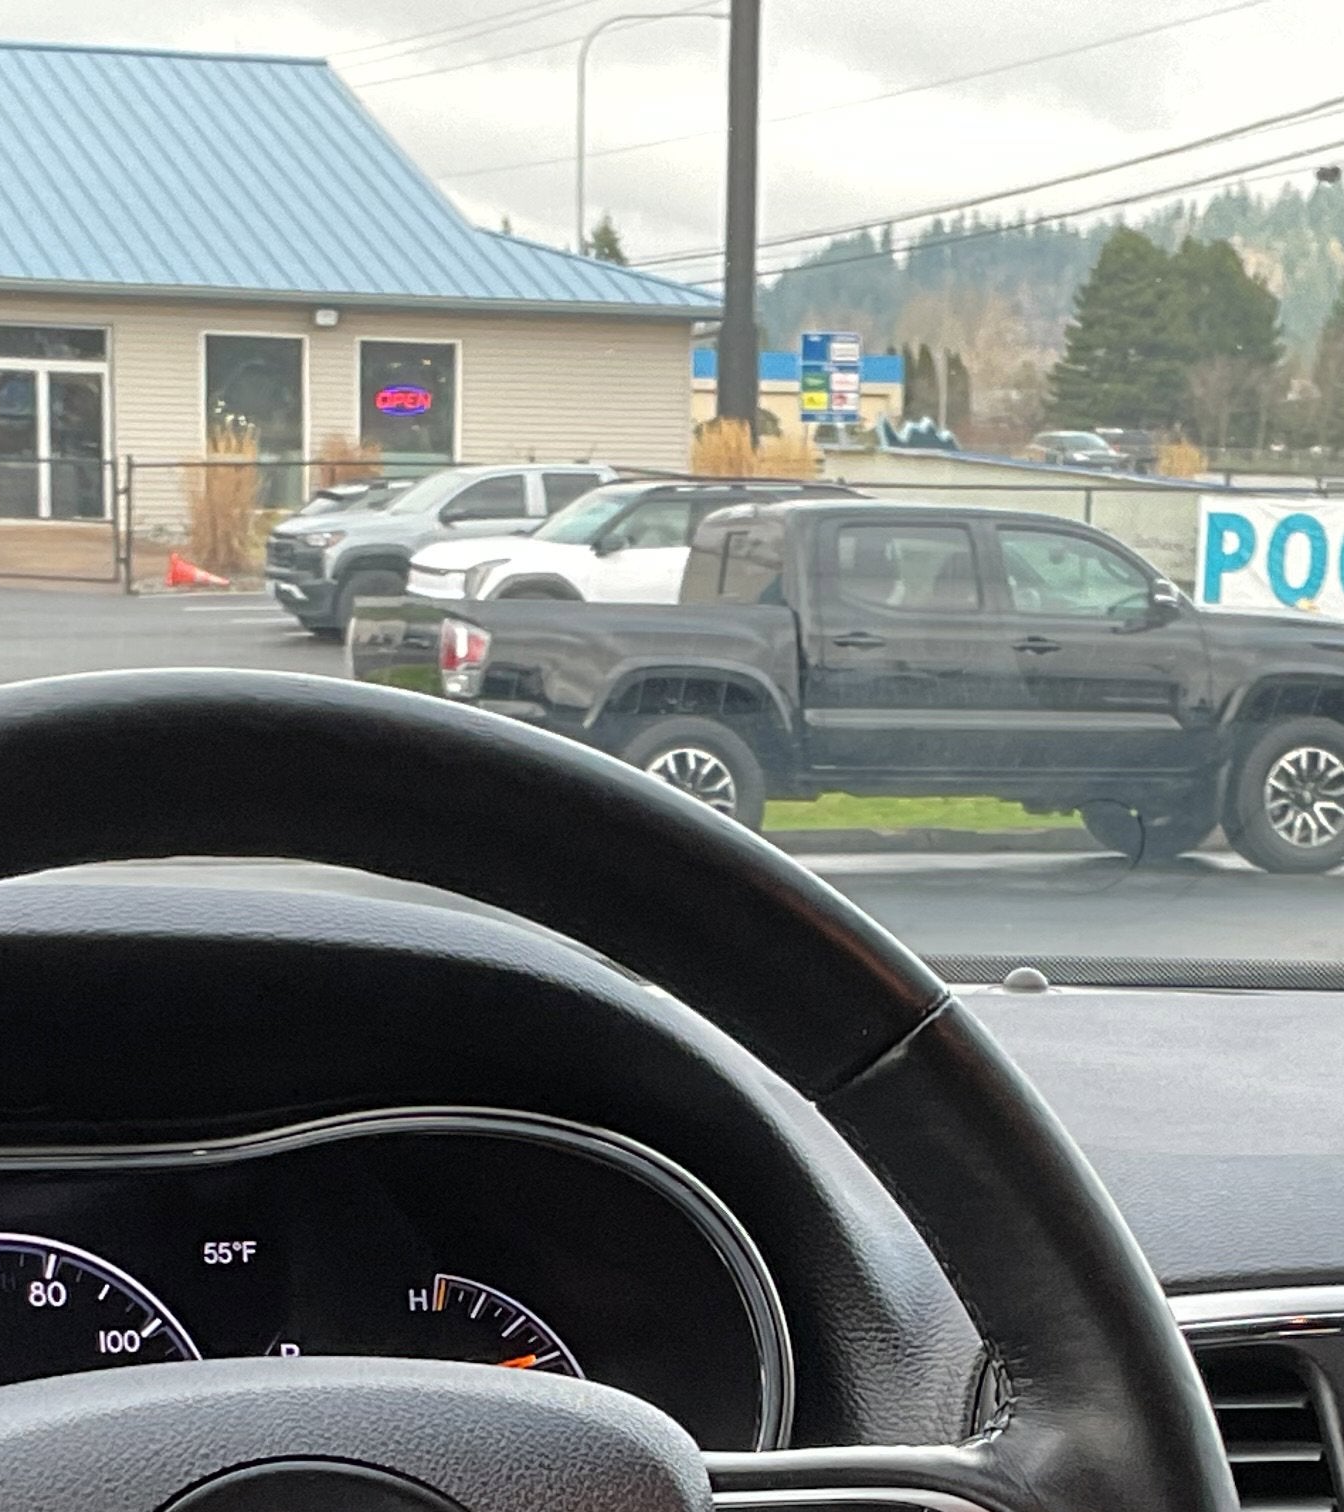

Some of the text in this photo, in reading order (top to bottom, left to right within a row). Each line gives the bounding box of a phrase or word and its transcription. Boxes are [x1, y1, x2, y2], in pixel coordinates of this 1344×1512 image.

[374, 389, 433, 411] OPEN
[203, 1241, 257, 1264] 55°F
[29, 1281, 67, 1307] 80
[408, 1288, 428, 1311] H
[99, 1330, 140, 1353] 100
